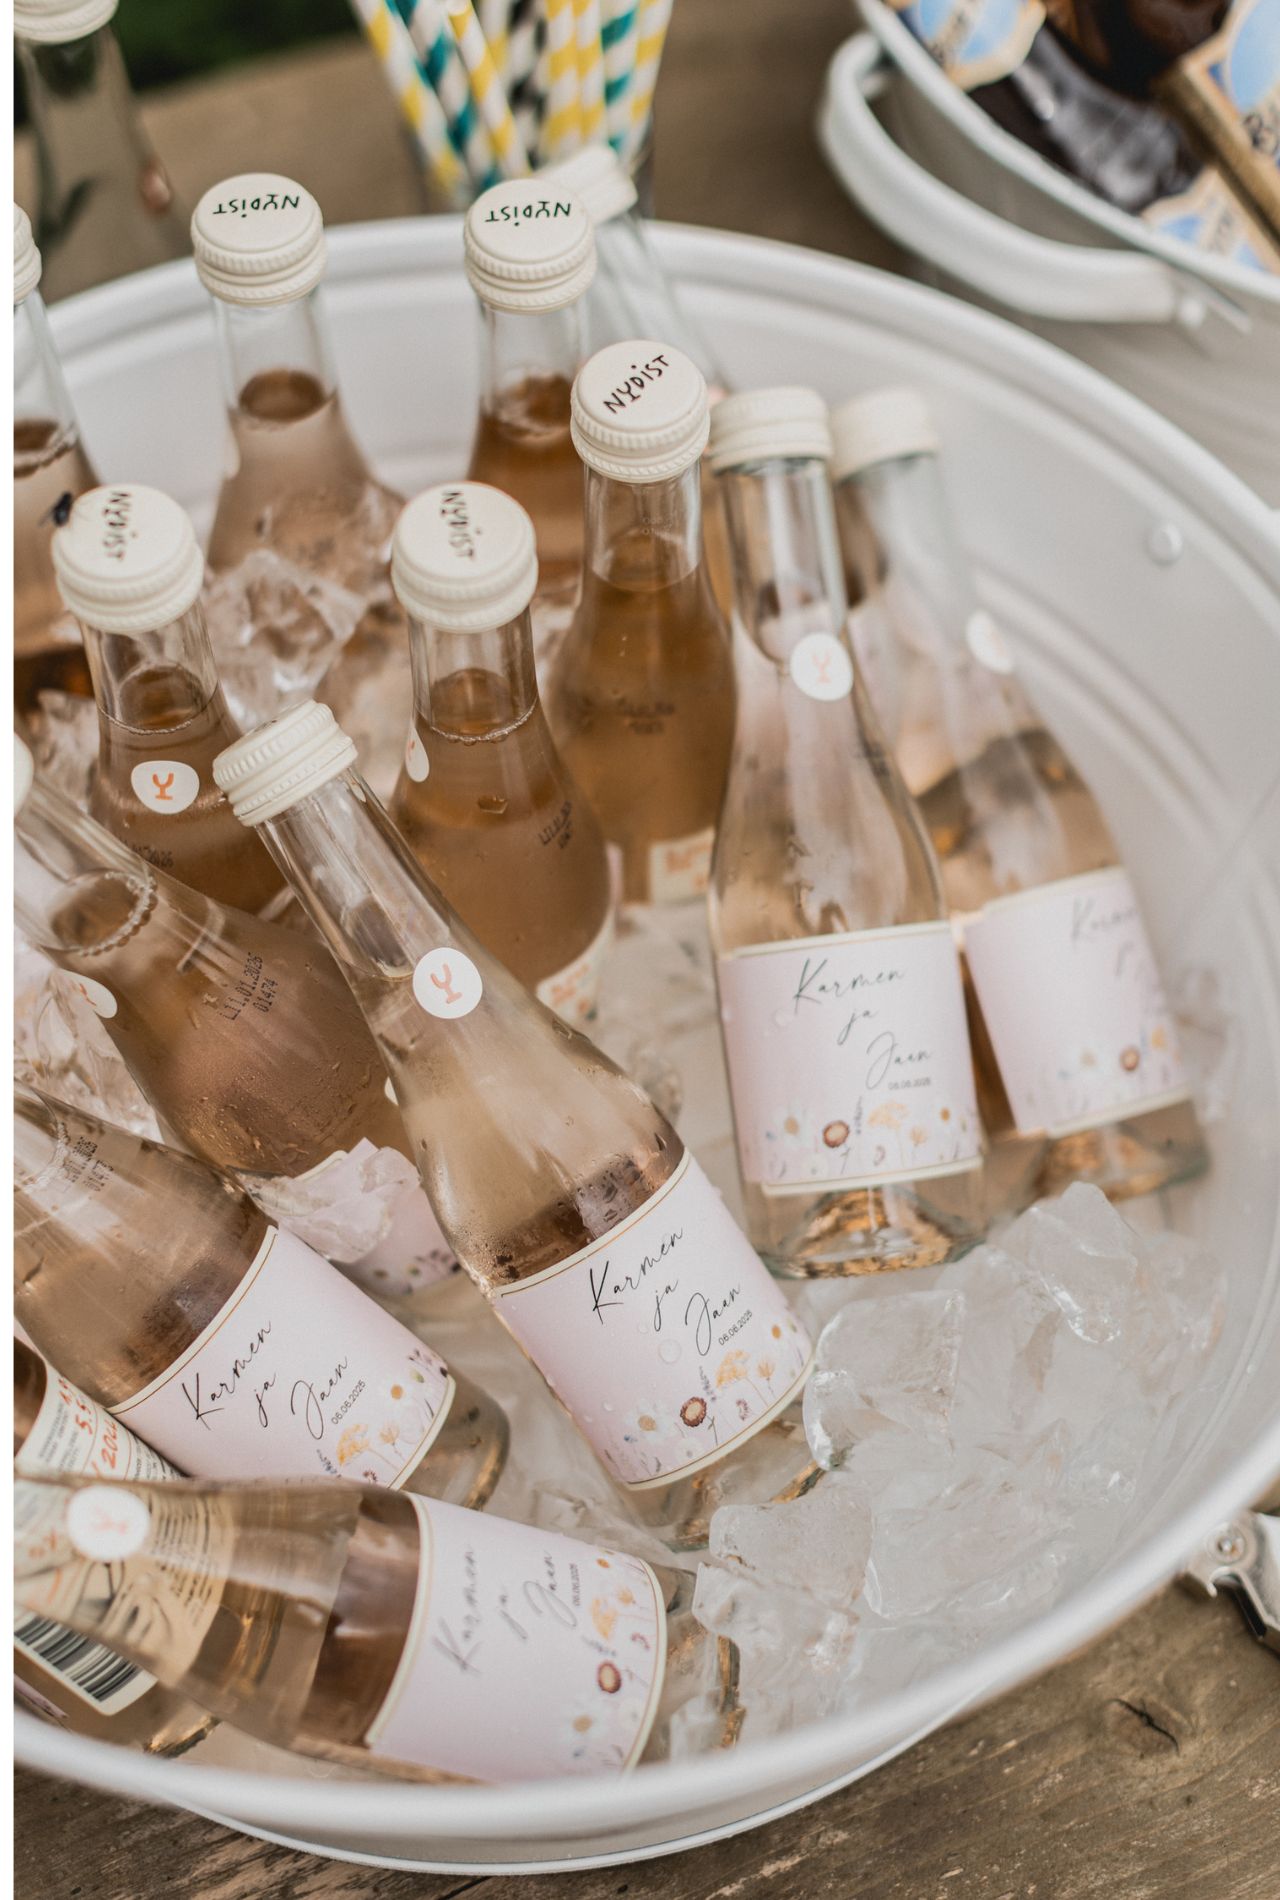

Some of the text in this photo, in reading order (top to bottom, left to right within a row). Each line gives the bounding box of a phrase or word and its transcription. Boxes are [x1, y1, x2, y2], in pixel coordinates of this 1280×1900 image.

[793, 958, 904, 1016] Karmen
[837, 1009, 879, 1046] ja
[865, 1031, 932, 1090] Jaan
[590, 1227, 683, 1325] Karmen
[653, 1279, 679, 1332] ja
[685, 1283, 741, 1357] Jaan
[717, 1309, 753, 1346] 06.06.2025
[182, 1320, 271, 1431] Karmen
[254, 1372, 276, 1428] ja
[291, 1356, 348, 1440] Jaan
[331, 1380, 366, 1425] 06.06.2025
